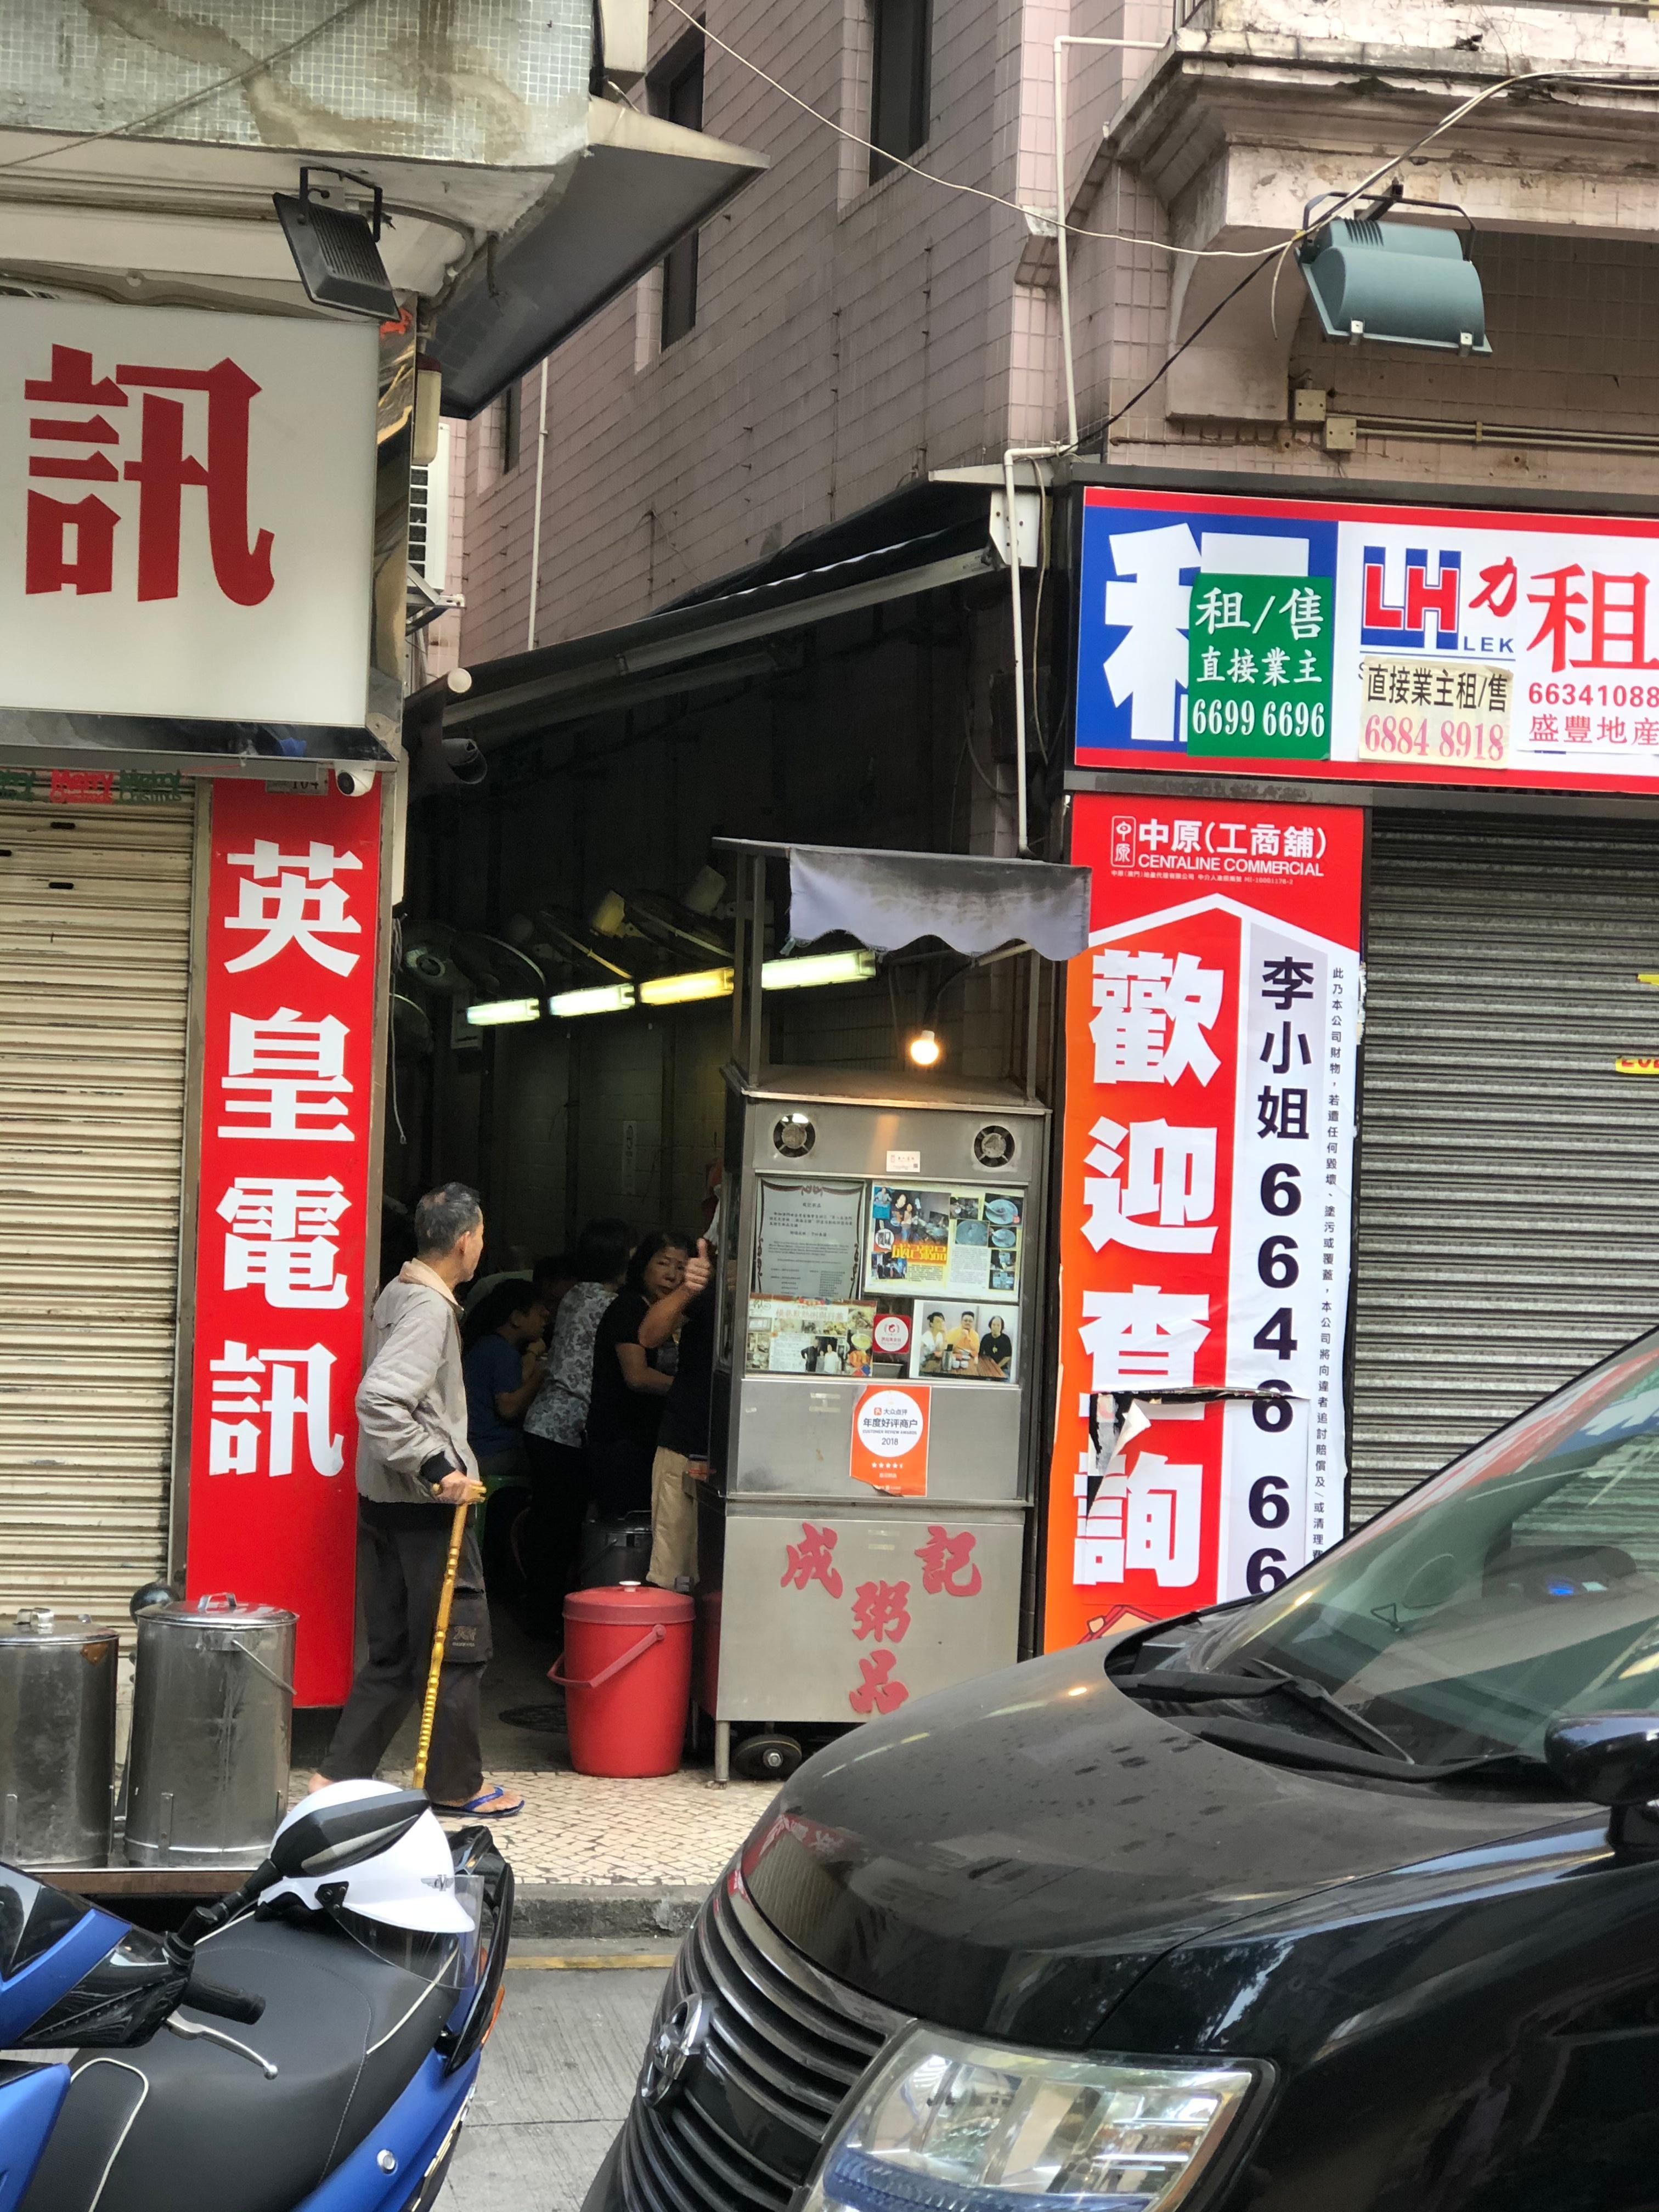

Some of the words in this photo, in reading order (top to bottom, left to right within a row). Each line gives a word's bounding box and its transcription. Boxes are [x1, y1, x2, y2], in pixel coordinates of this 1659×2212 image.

[25, 343, 275, 606] 訊
[1195, 587, 1324, 640] 租/售
[1361, 546, 1462, 650] LH
[1527, 563, 1659, 673] 租
[1197, 646, 1323, 687] 直接業主
[1464, 636, 1514, 653] LEK
[1368, 664, 1508, 713] 直接業主租/售
[1528, 682, 1659, 708] 66341088
[1192, 699, 1255, 735] 6699
[1263, 701, 1325, 737] 6696
[1365, 714, 1429, 756] 6884
[1439, 720, 1504, 761] 8918
[1138, 854, 1221, 871] CENTALINE
[1223, 858, 1325, 877] COMMERCIAL
[1257, 956, 1314, 1140] 李小姐
[209, 838, 363, 1477] 英皇電訊
[1073, 949, 1224, 1588] 歡迎查詢
[863, 1418, 918, 1429] 年度好评商户
[881, 1437, 899, 1446] 2018
